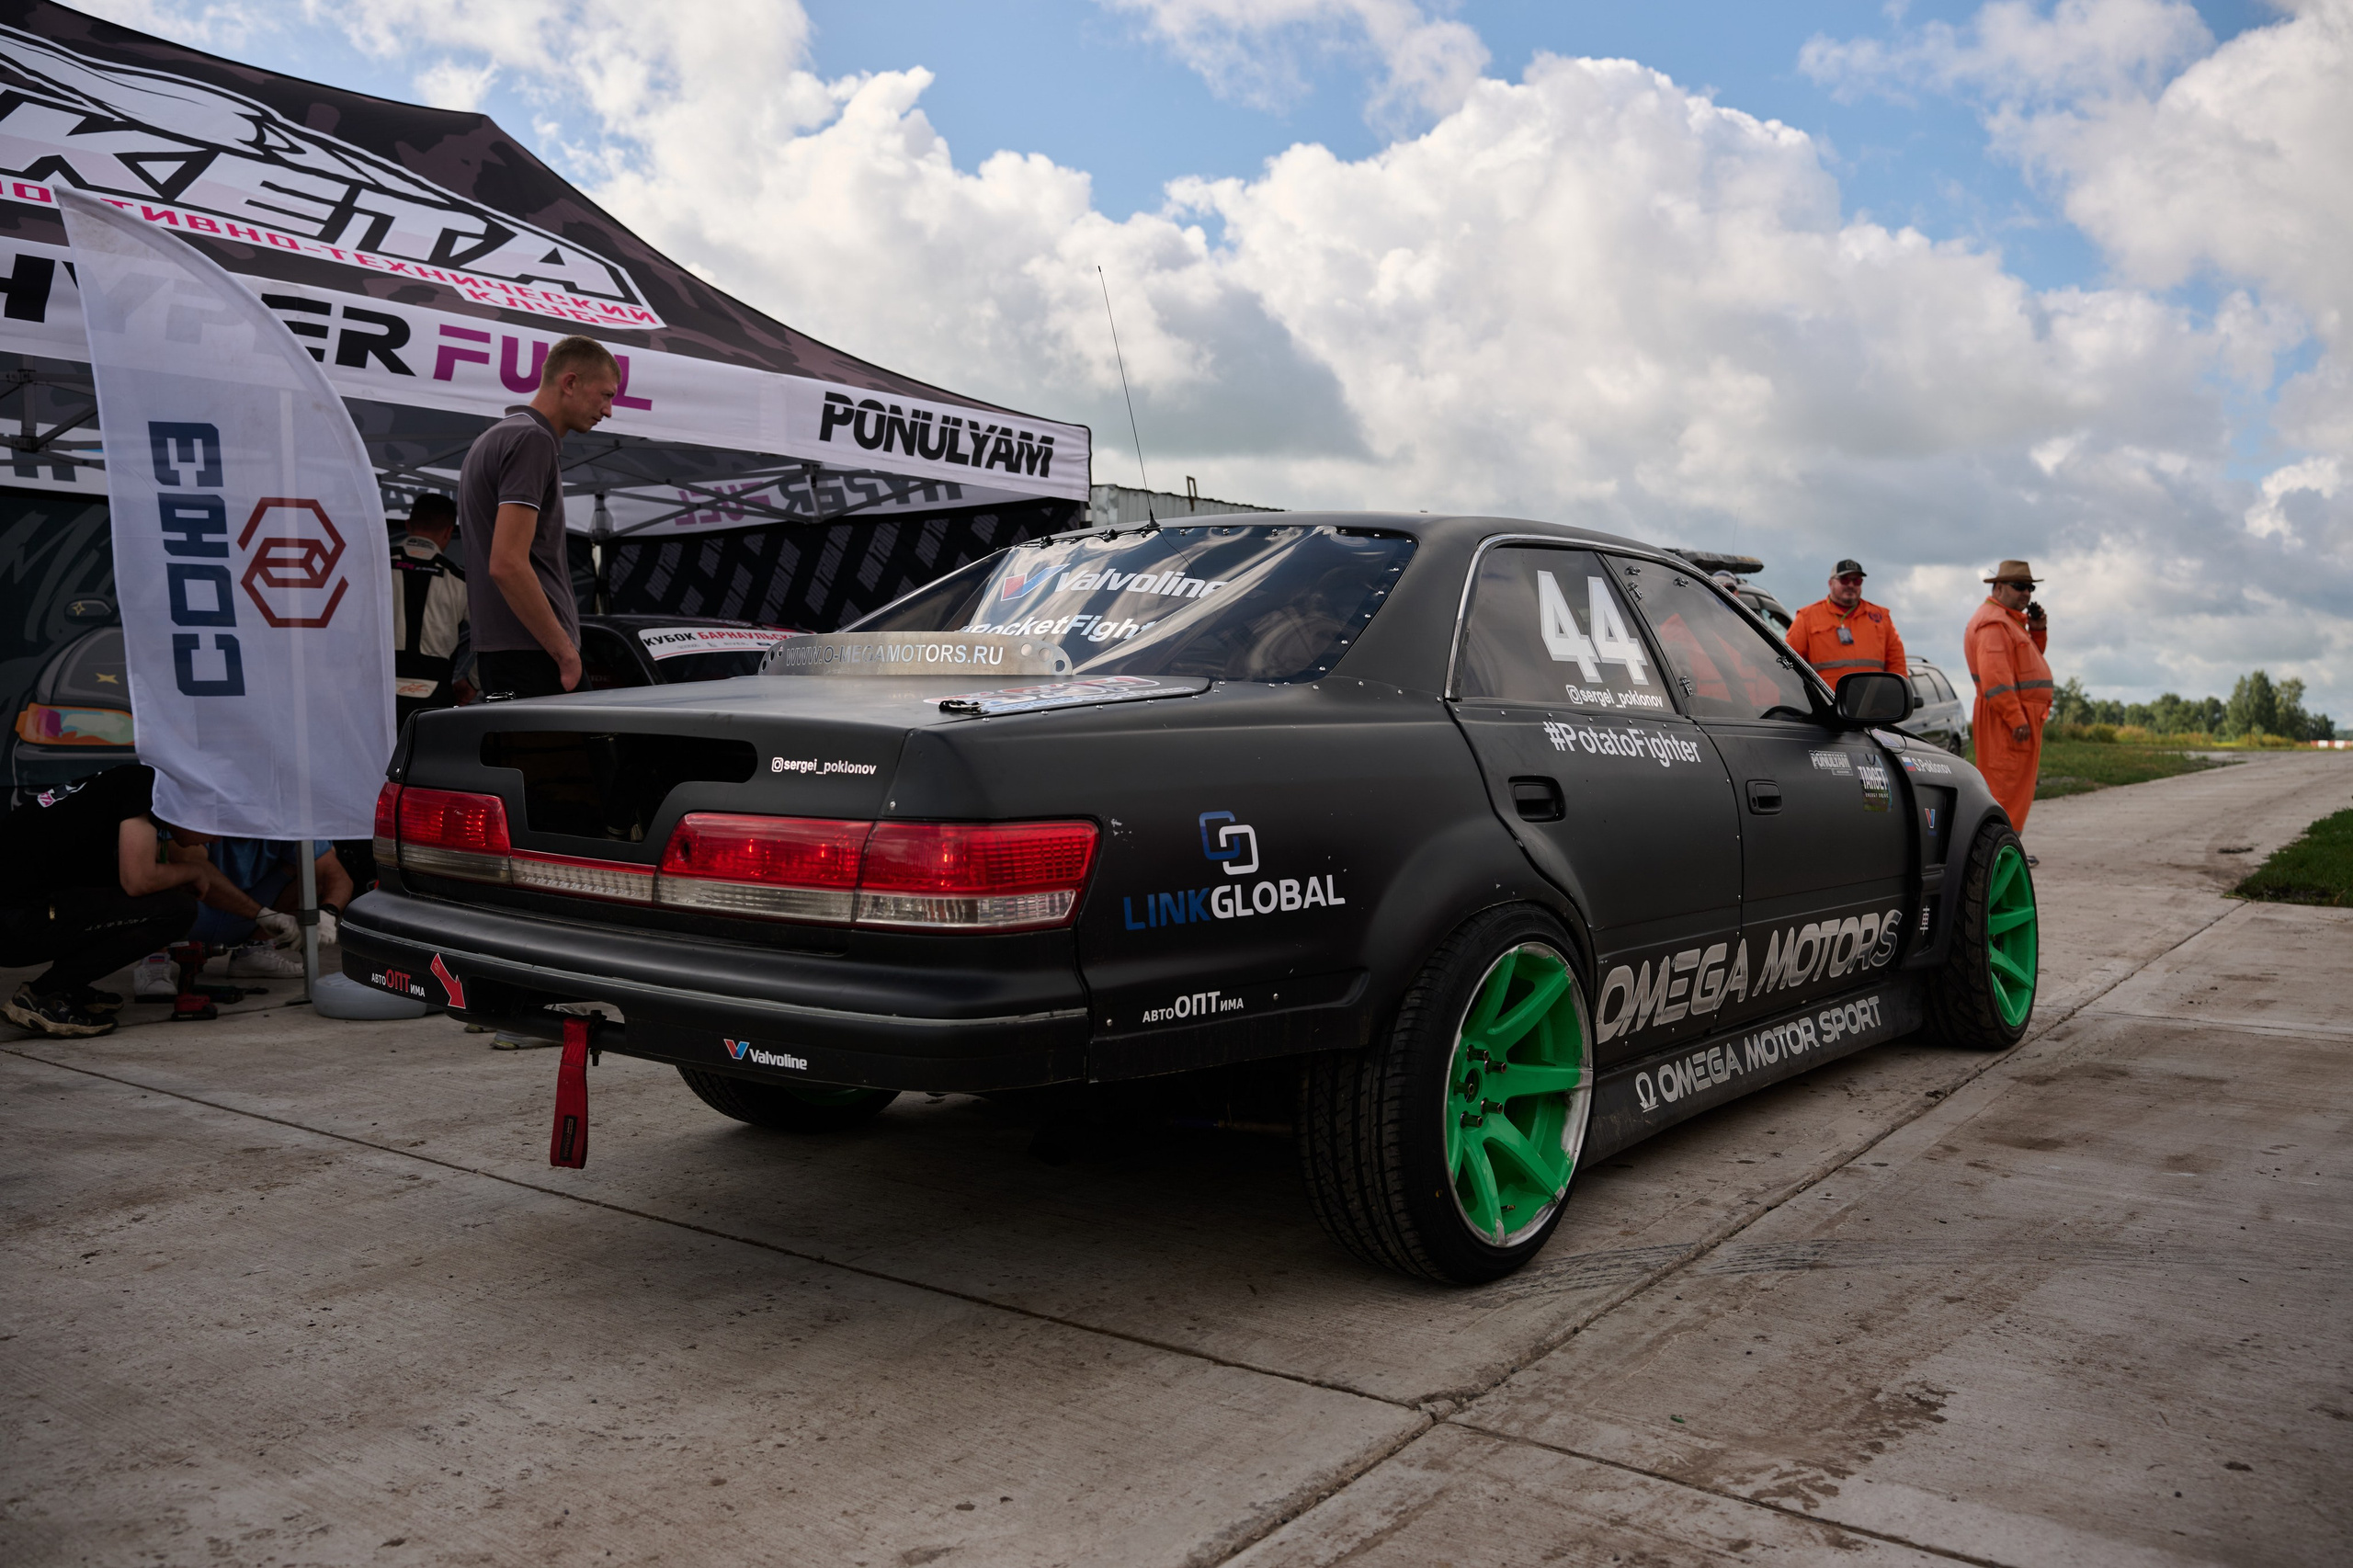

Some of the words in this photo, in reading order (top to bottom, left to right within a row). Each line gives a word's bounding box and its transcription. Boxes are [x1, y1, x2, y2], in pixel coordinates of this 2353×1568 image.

[464, 288, 601, 324] КЛУБ
[433, 324, 654, 412] FUL
[819, 391, 1055, 478] PONULYAM
[147, 420, 246, 697] СОЮЗ
[643, 632, 697, 646] КУБОК
[697, 631, 797, 642] БАРНАУЛЬСК
[1537, 570, 1649, 686] 44
[783, 758, 878, 775] sergei_poklonov
[1542, 721, 1702, 768] #PotatoFighter
[1857, 766, 1888, 790] TARGET
[1597, 937, 1749, 1045] OMEGA
[1752, 909, 1904, 997] MOTORS
[749, 1048, 808, 1071] Valvoline
[1657, 1042, 1744, 1103] OMEGA
[1744, 1017, 1820, 1073] MOTOR
[1818, 995, 1882, 1044] SPORT
